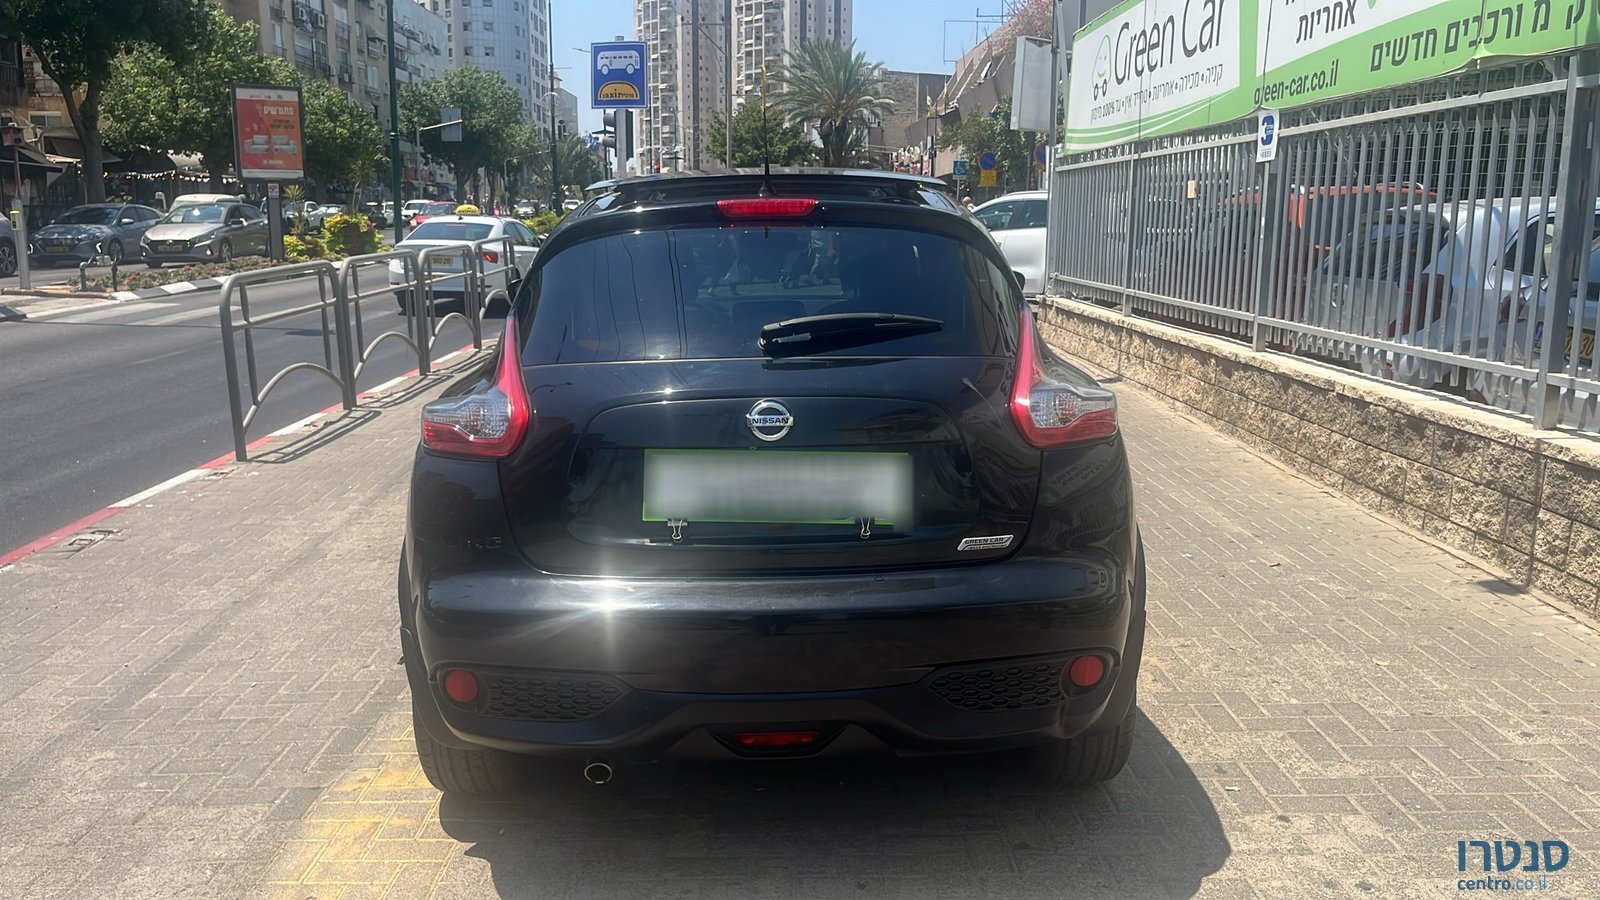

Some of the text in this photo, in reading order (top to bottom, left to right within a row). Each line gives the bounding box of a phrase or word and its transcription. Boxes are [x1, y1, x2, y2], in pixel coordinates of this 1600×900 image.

[1296, 0, 1357, 44] אחריות
[1444, 3, 1523, 54] ורכבים
[1114, 0, 1224, 85] Green Car
[1370, 27, 1438, 72] חדשים
[1151, 80, 1175, 102] אחריות
[1178, 71, 1200, 93] מכירה
[1205, 63, 1223, 87] קניה
[751, 417, 790, 425] NISSAN
